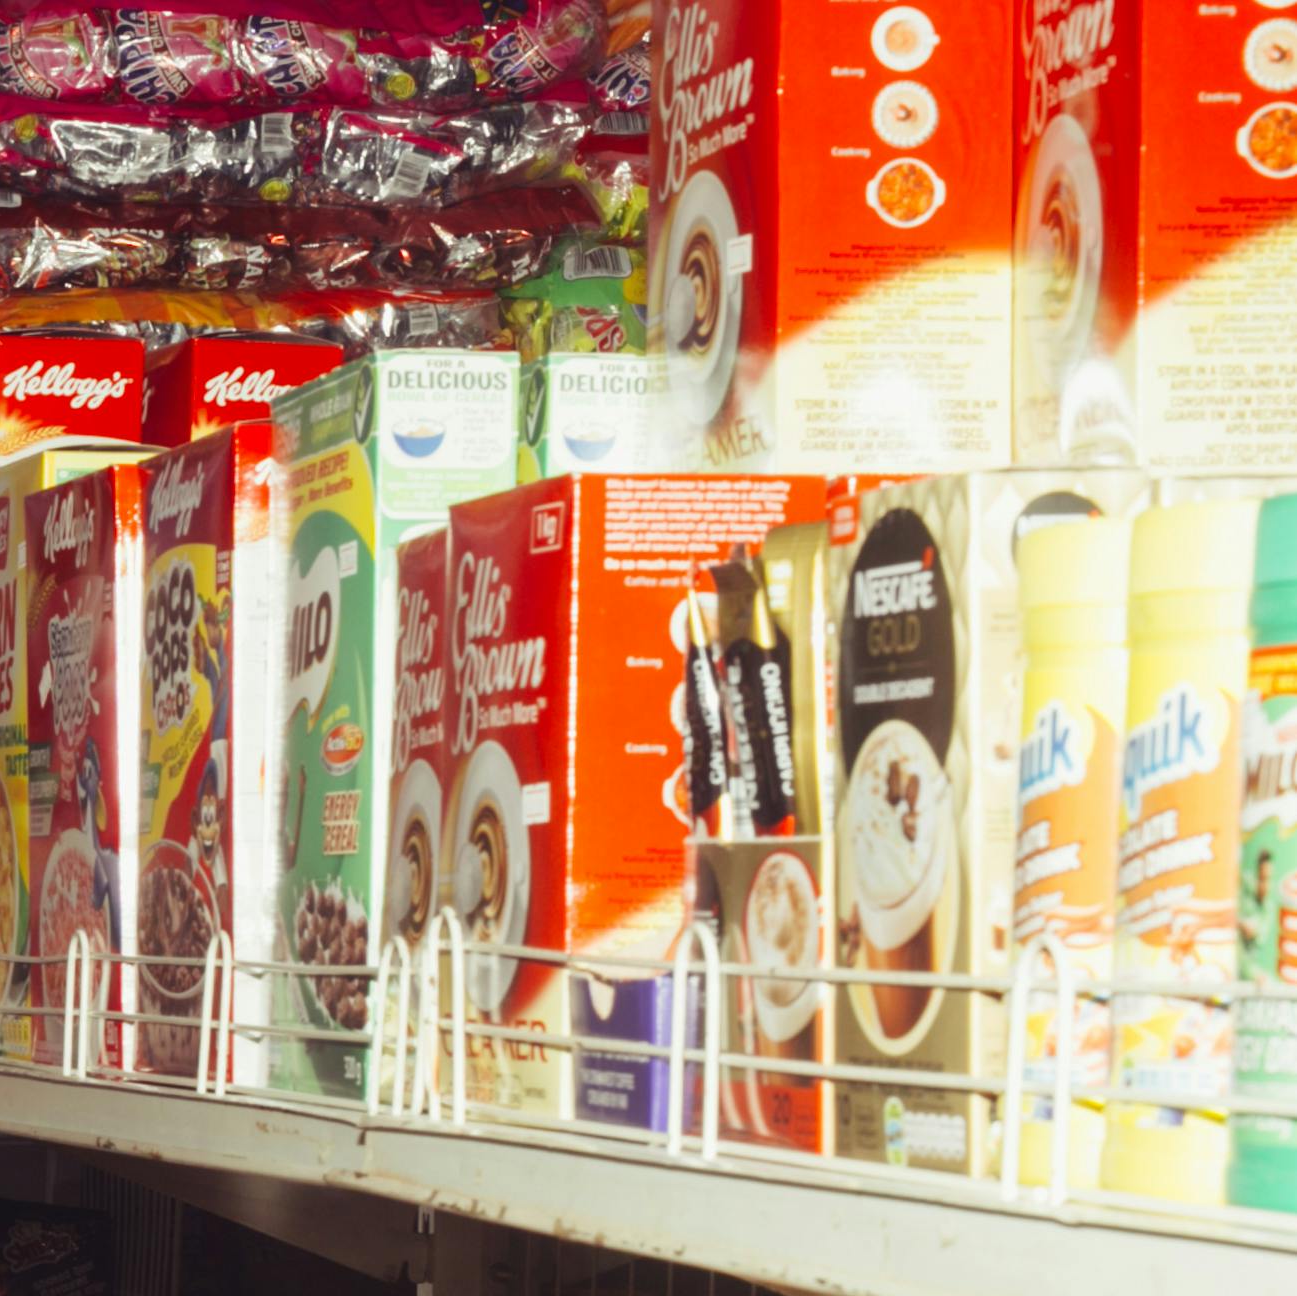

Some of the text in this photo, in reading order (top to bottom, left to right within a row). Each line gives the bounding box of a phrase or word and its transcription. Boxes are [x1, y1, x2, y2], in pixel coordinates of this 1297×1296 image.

[3, 361, 130, 410] Kellogg's
[387, 369, 507, 391] DELICIOUS
[867, 616, 921, 656] GOLD
